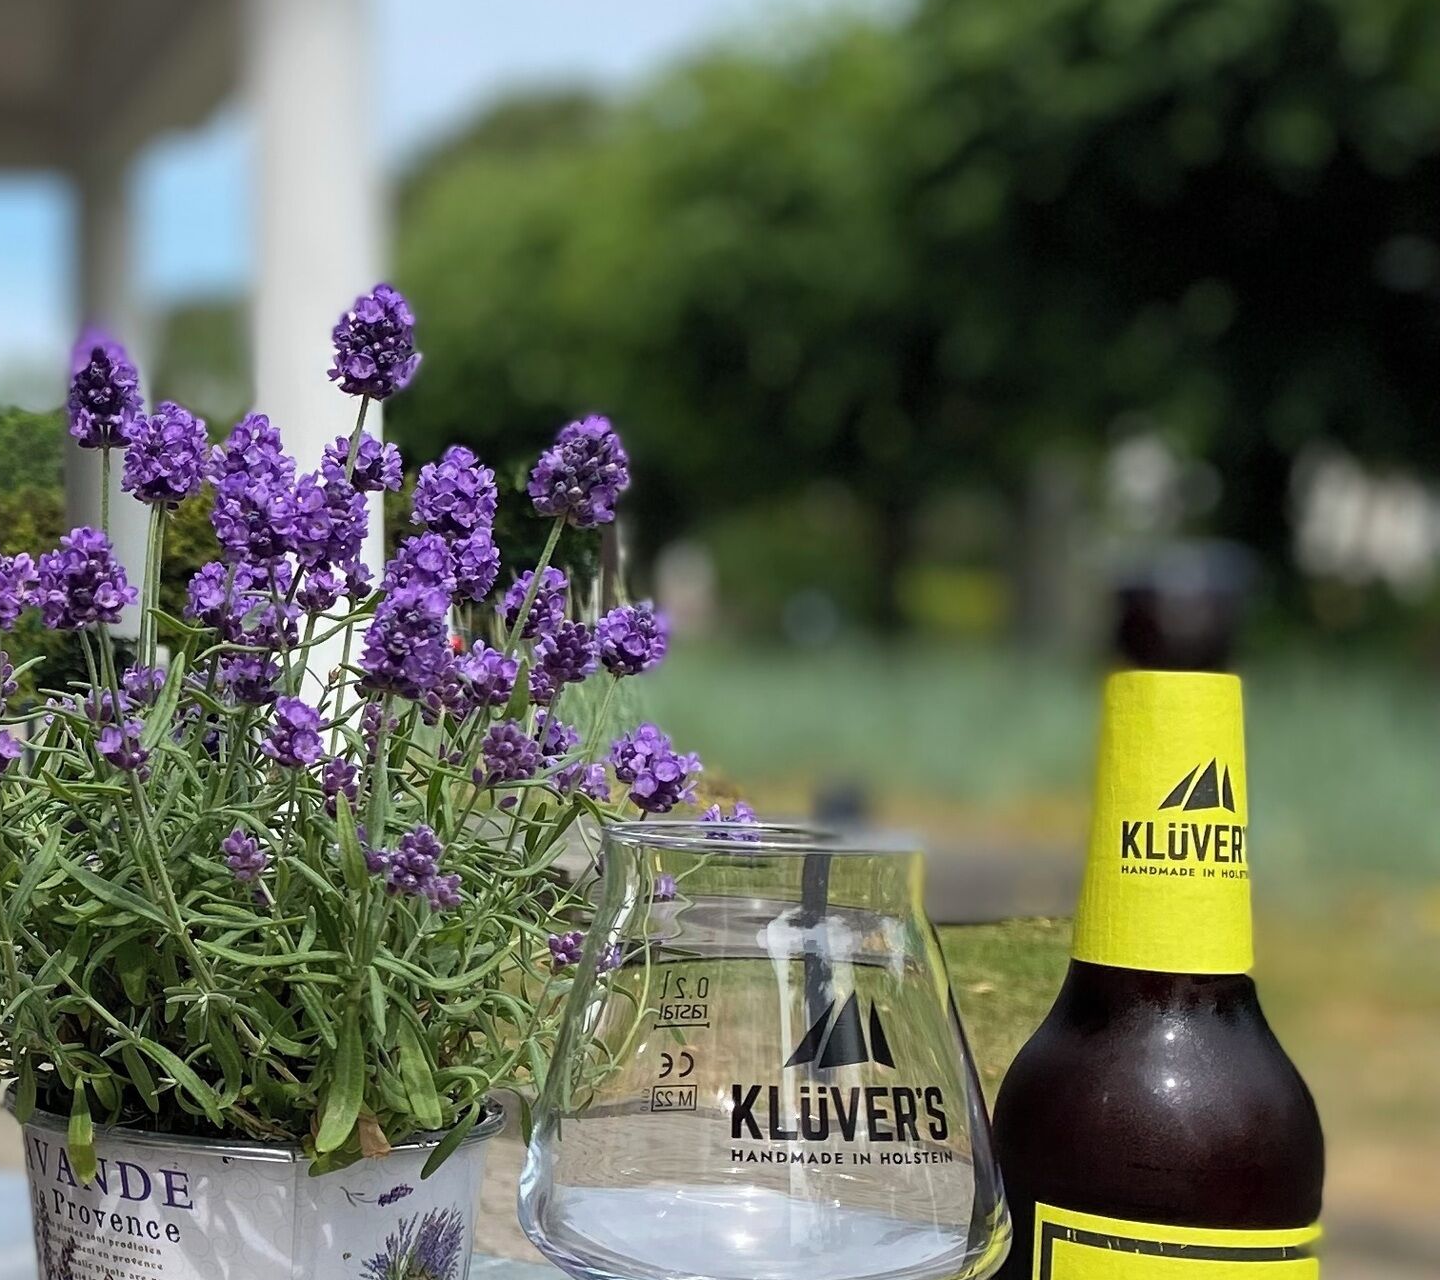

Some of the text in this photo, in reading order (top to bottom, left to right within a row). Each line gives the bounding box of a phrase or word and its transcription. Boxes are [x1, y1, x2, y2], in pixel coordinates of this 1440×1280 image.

[1121, 865, 1195, 877] HANDMADE
[1203, 869, 1215, 877] IN
[731, 1149, 953, 1165] HANDMADE IN HOLSTEIN
[52, 1188, 182, 1244] Provence
